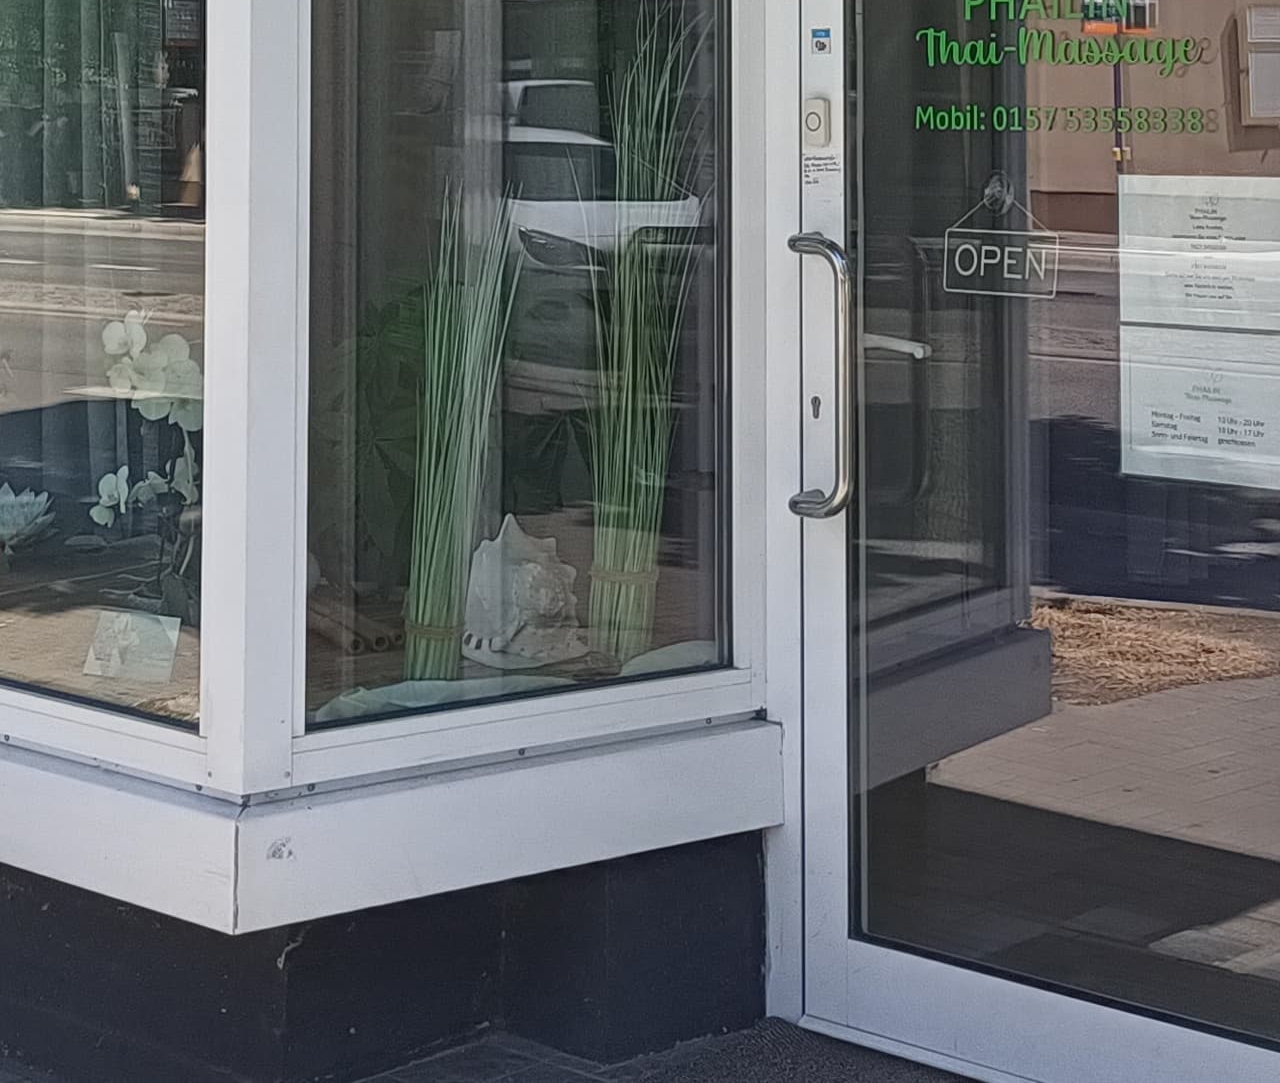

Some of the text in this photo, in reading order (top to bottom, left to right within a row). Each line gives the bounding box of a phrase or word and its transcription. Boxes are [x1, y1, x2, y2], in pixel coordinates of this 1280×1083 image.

[916, 26, 1204, 77] Thai-Massage
[915, 105, 985, 132] Mobil:
[993, 106, 1058, 132] 0157
[954, 244, 1046, 280] OPEN
